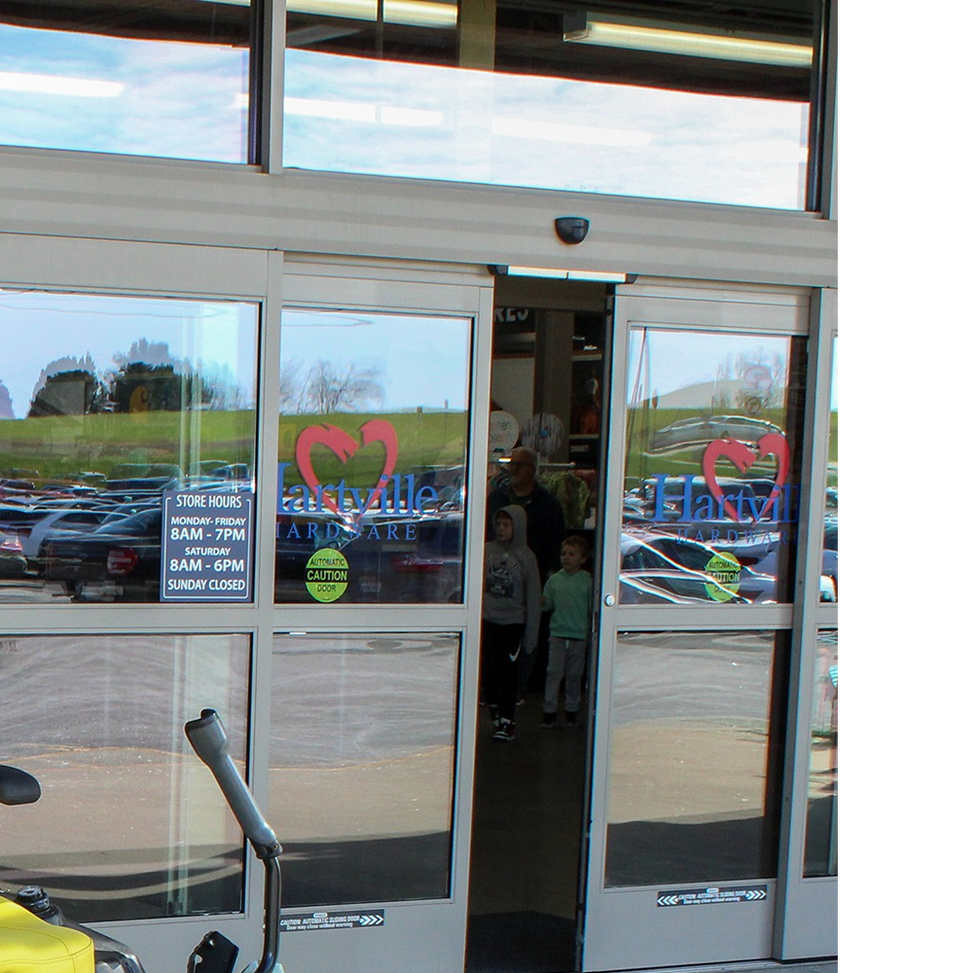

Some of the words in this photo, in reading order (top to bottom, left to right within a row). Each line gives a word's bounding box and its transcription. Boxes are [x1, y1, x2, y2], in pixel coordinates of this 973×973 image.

[176, 494, 206, 508] STORE
[208, 495, 242, 508] HOURS
[215, 517, 246, 526] FRIDAY
[171, 528, 203, 540] 8AM
[215, 529, 245, 541] 7PM
[185, 547, 231, 556] SATURDAY
[170, 559, 202, 572] 8AM
[214, 560, 244, 572] 6PM
[310, 557, 345, 566] AUTOMATIC
[307, 570, 347, 581] CAUTION
[168, 579, 207, 590] SUNDAY
[209, 579, 245, 591] CLOSED
[317, 584, 336, 592] DOOR
[302, 917, 328, 925] AUTOMATIC
